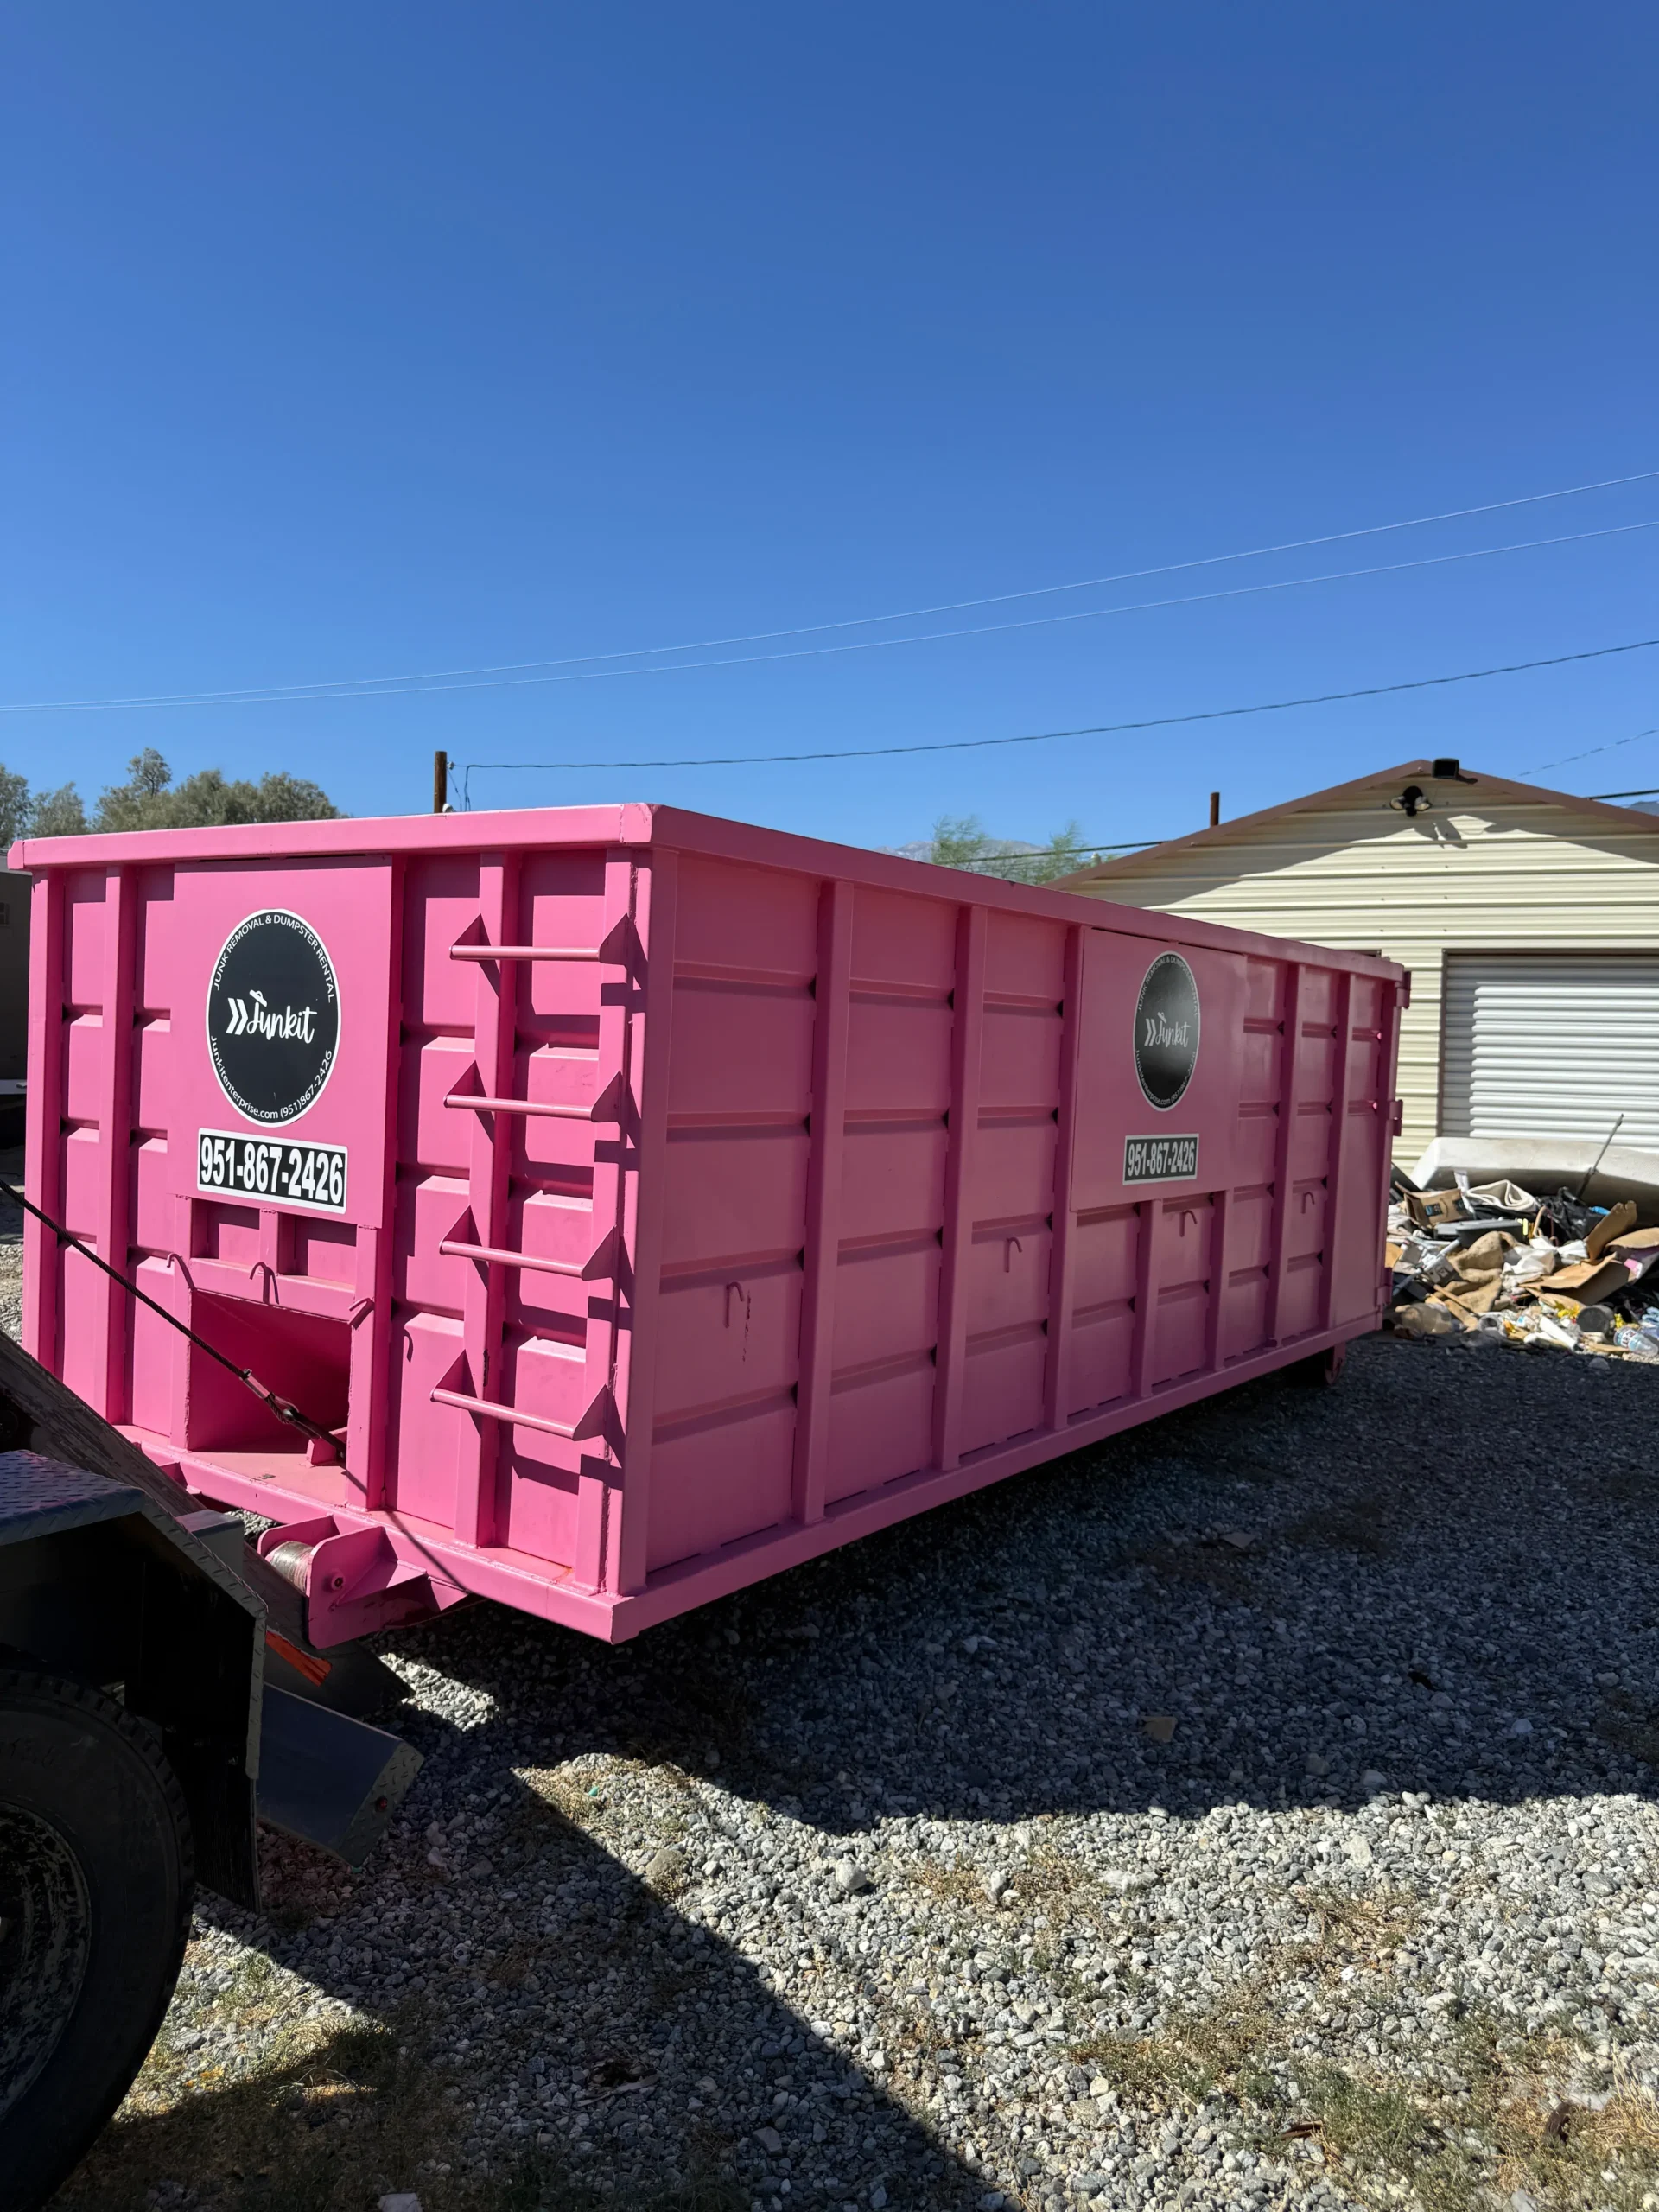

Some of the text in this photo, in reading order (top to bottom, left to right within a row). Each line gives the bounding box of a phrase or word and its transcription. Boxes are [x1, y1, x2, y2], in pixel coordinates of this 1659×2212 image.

[213, 914, 335, 1003] JUNK REMOVAL & DUMPSTER RENTAL
[246, 1000, 318, 1044] Junkit
[1155, 1020, 1192, 1048] Junkit
[211, 1035, 333, 1119] Junkitenterprise.com (951)867-2426
[200, 1136, 344, 1204] 951-867-2426
[1128, 1141, 1195, 1177] 951-867-2426
